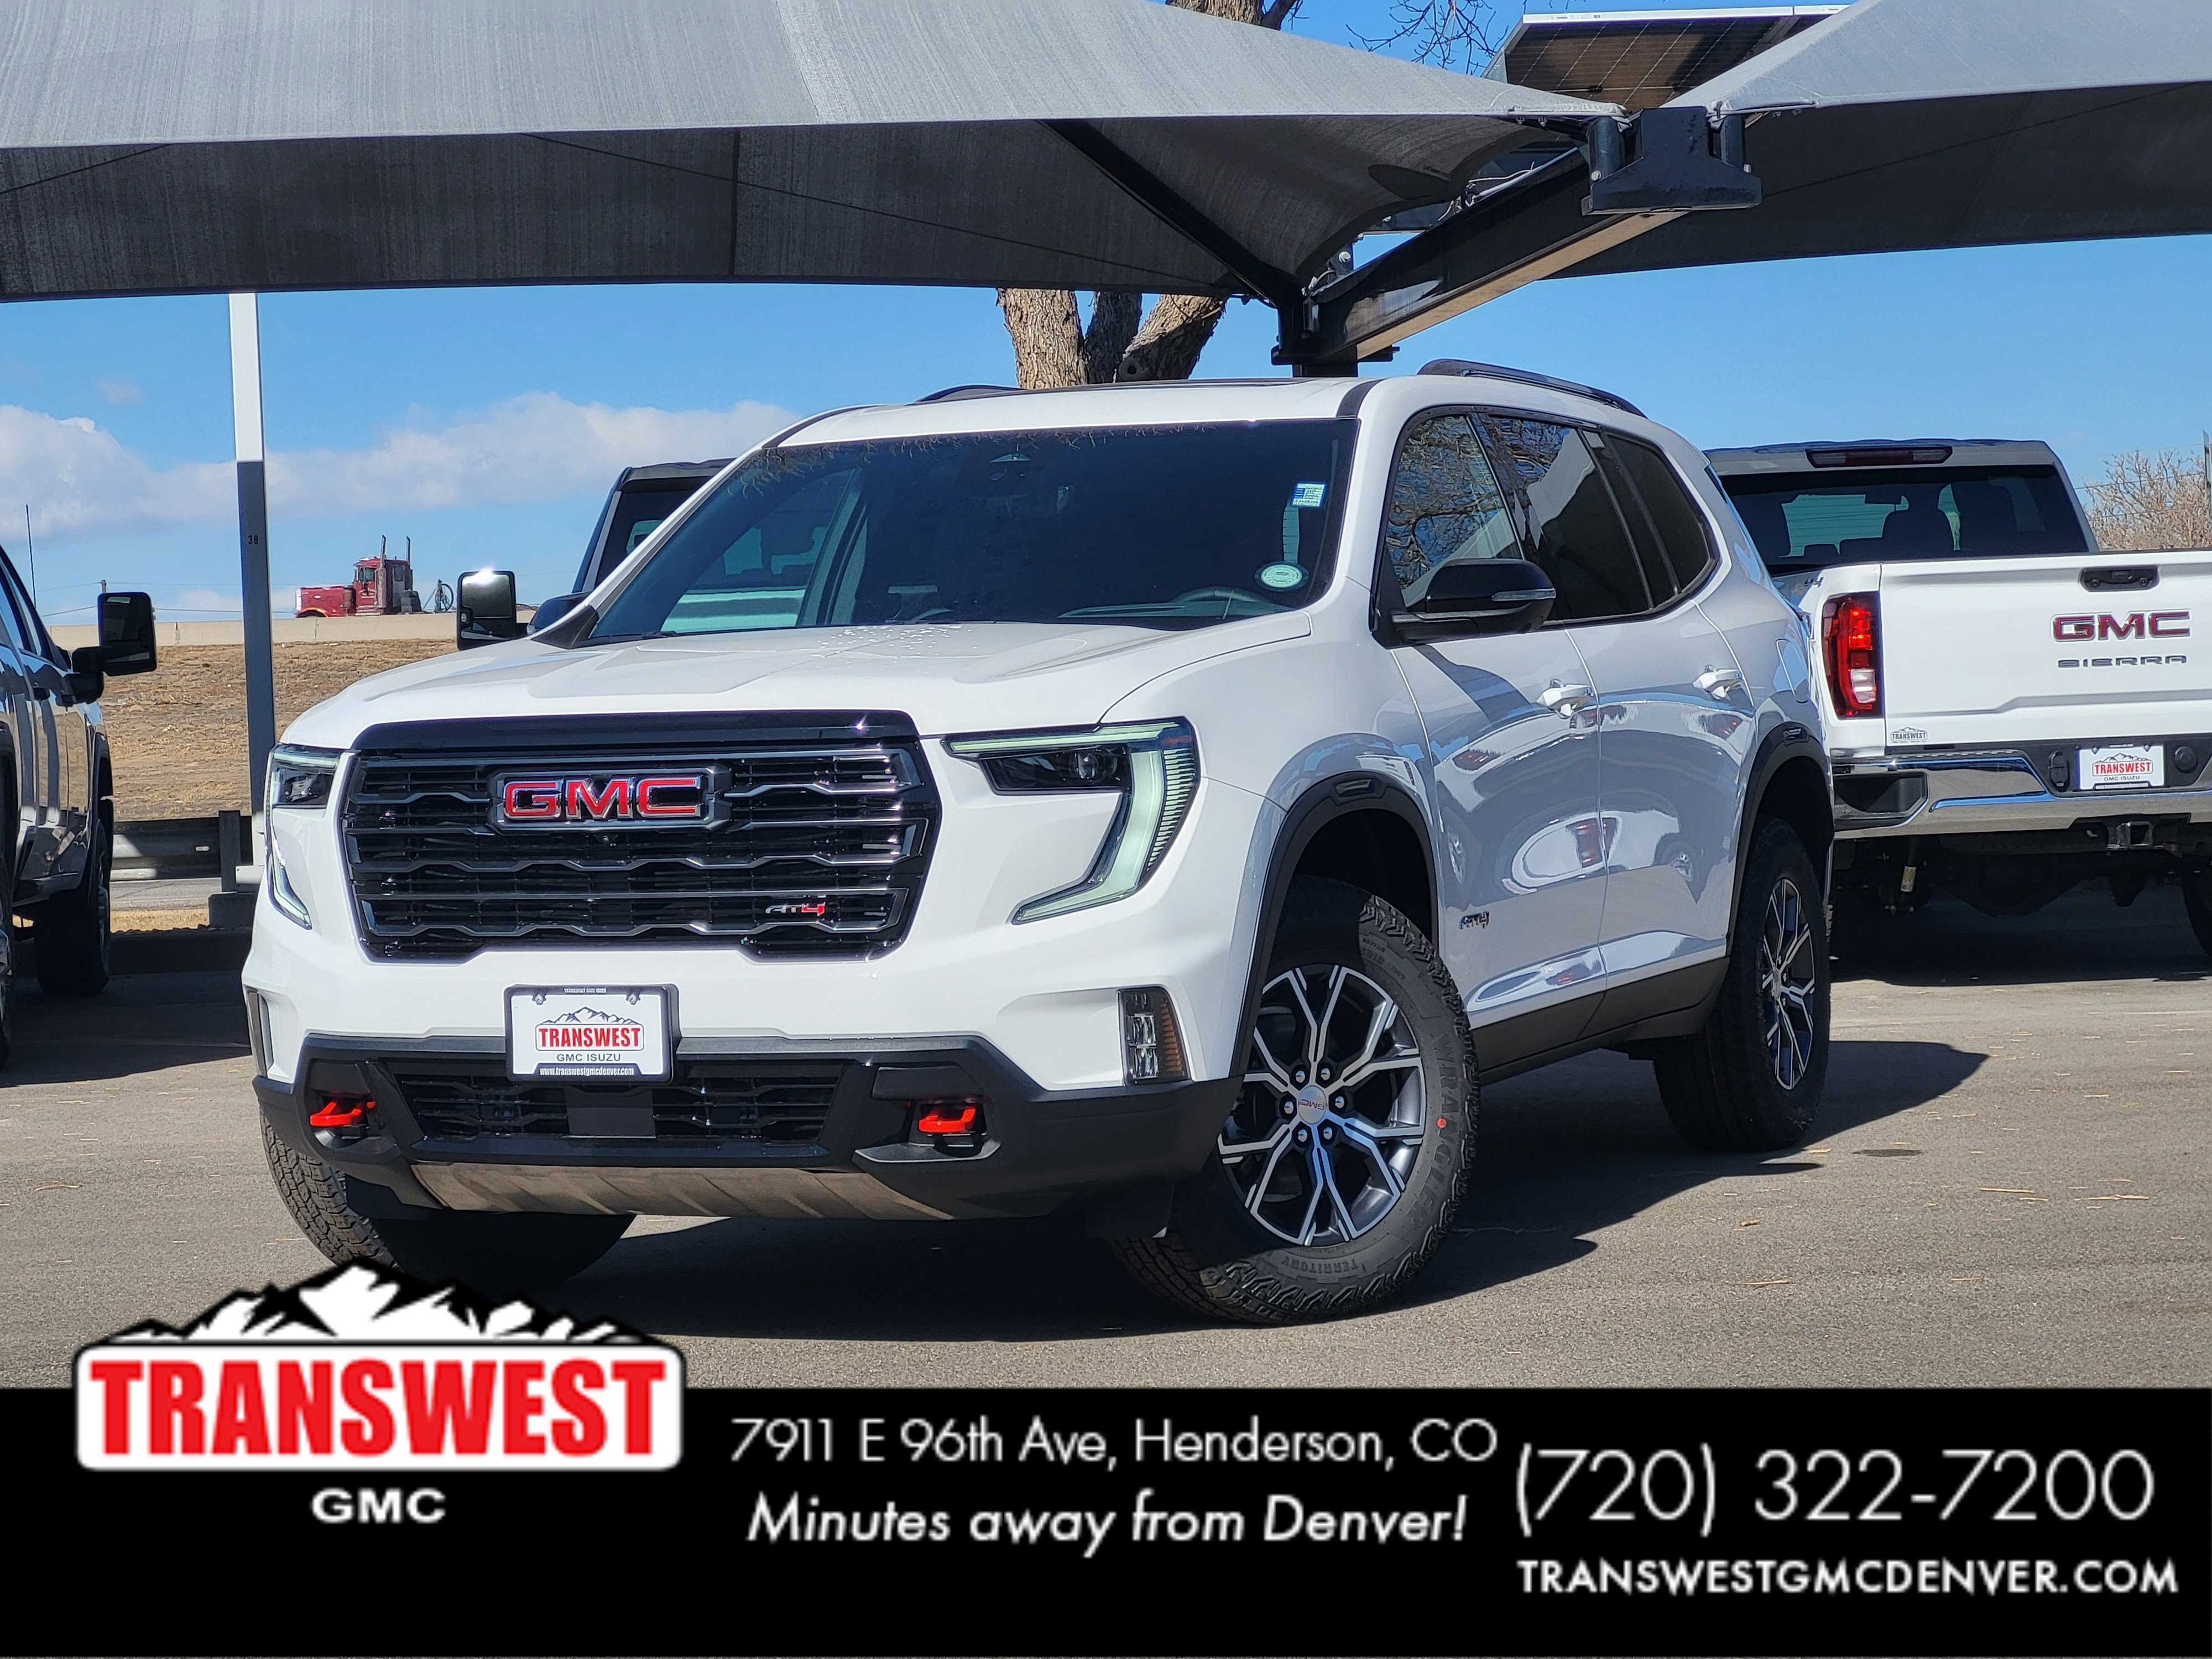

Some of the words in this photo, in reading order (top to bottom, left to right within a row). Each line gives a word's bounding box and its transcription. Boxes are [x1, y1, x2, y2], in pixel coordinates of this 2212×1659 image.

[248, 535, 258, 545] 38
[2053, 610, 2190, 641] GMC
[2058, 655, 2187, 668] SIERRA
[2094, 762, 2151, 774] TRANSWEST
[503, 776, 701, 820] GMC
[765, 902, 826, 916] AT4
[1460, 911, 1489, 930] AT4
[539, 1027, 640, 1047] TRANSWEST
[539, 1067, 634, 1077] www.transwestgmcdenver.com
[1300, 1099, 1325, 1111] GMC
